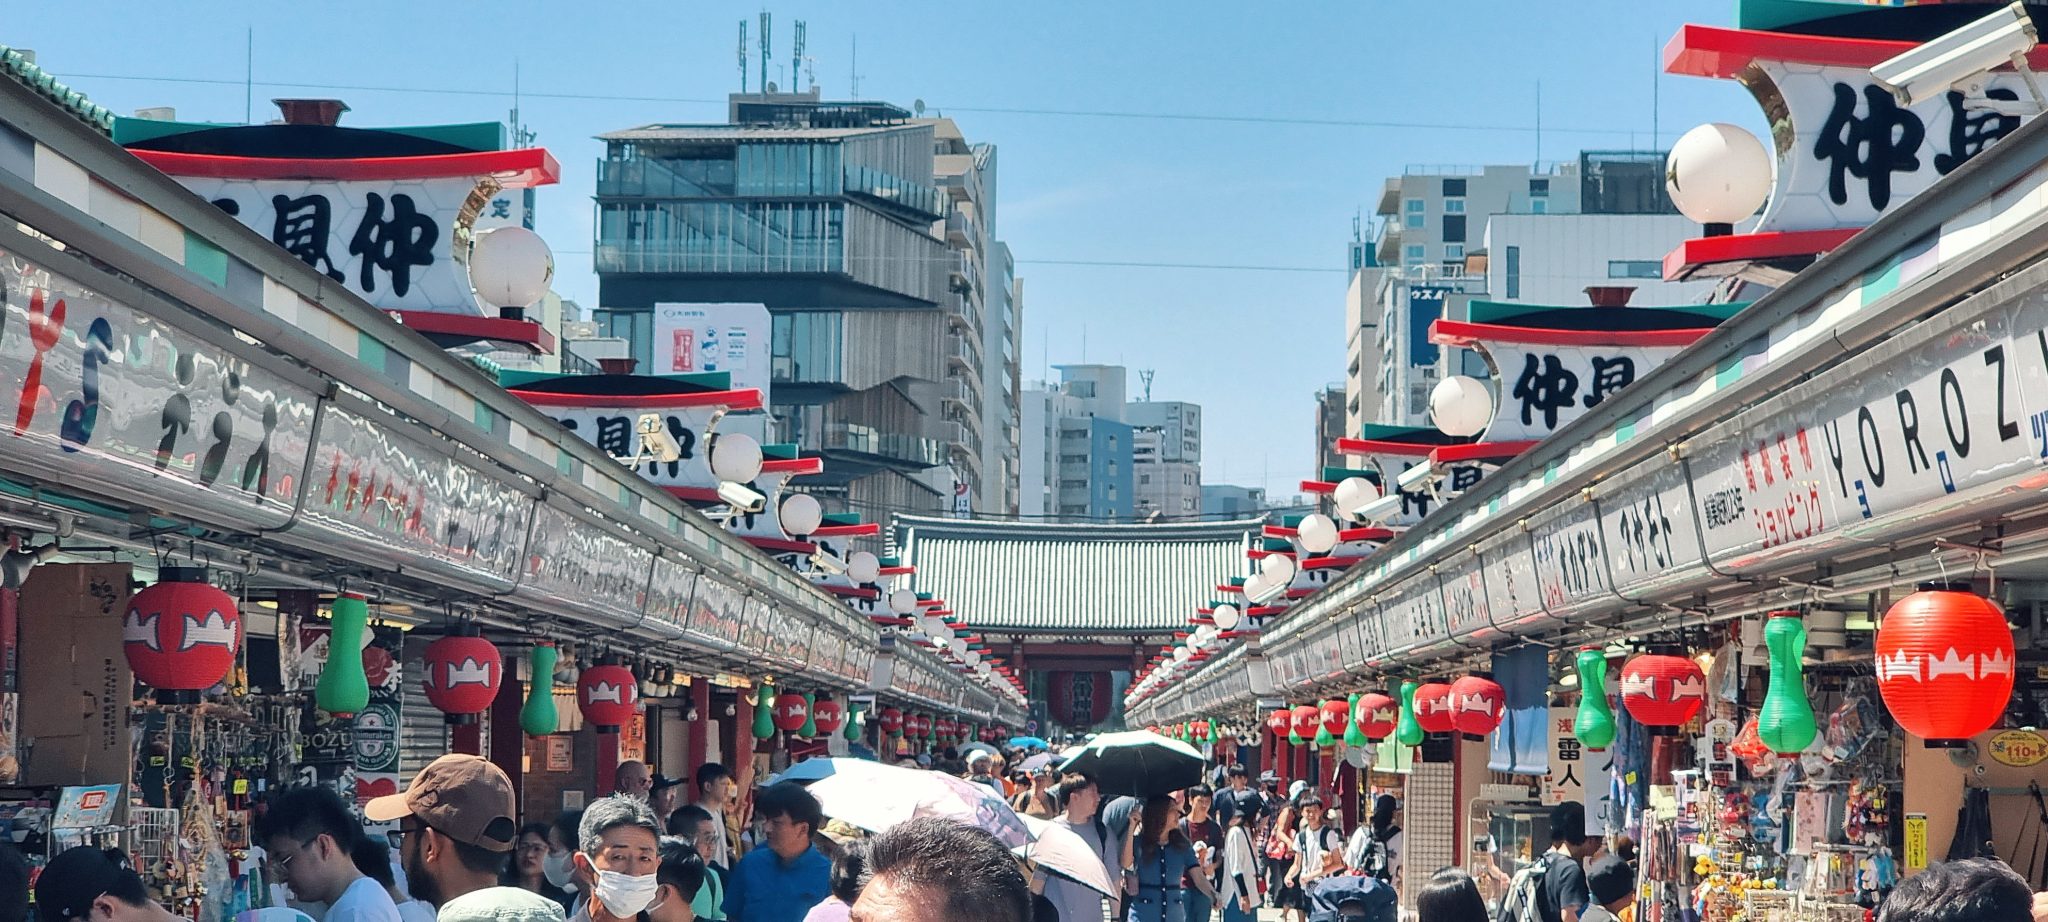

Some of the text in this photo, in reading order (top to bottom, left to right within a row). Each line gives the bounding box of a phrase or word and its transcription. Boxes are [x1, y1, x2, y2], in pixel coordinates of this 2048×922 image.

[480, 198, 511, 219] 定
[1753, 482, 1823, 549] ショッピング
[1558, 719, 1573, 733] 浅
